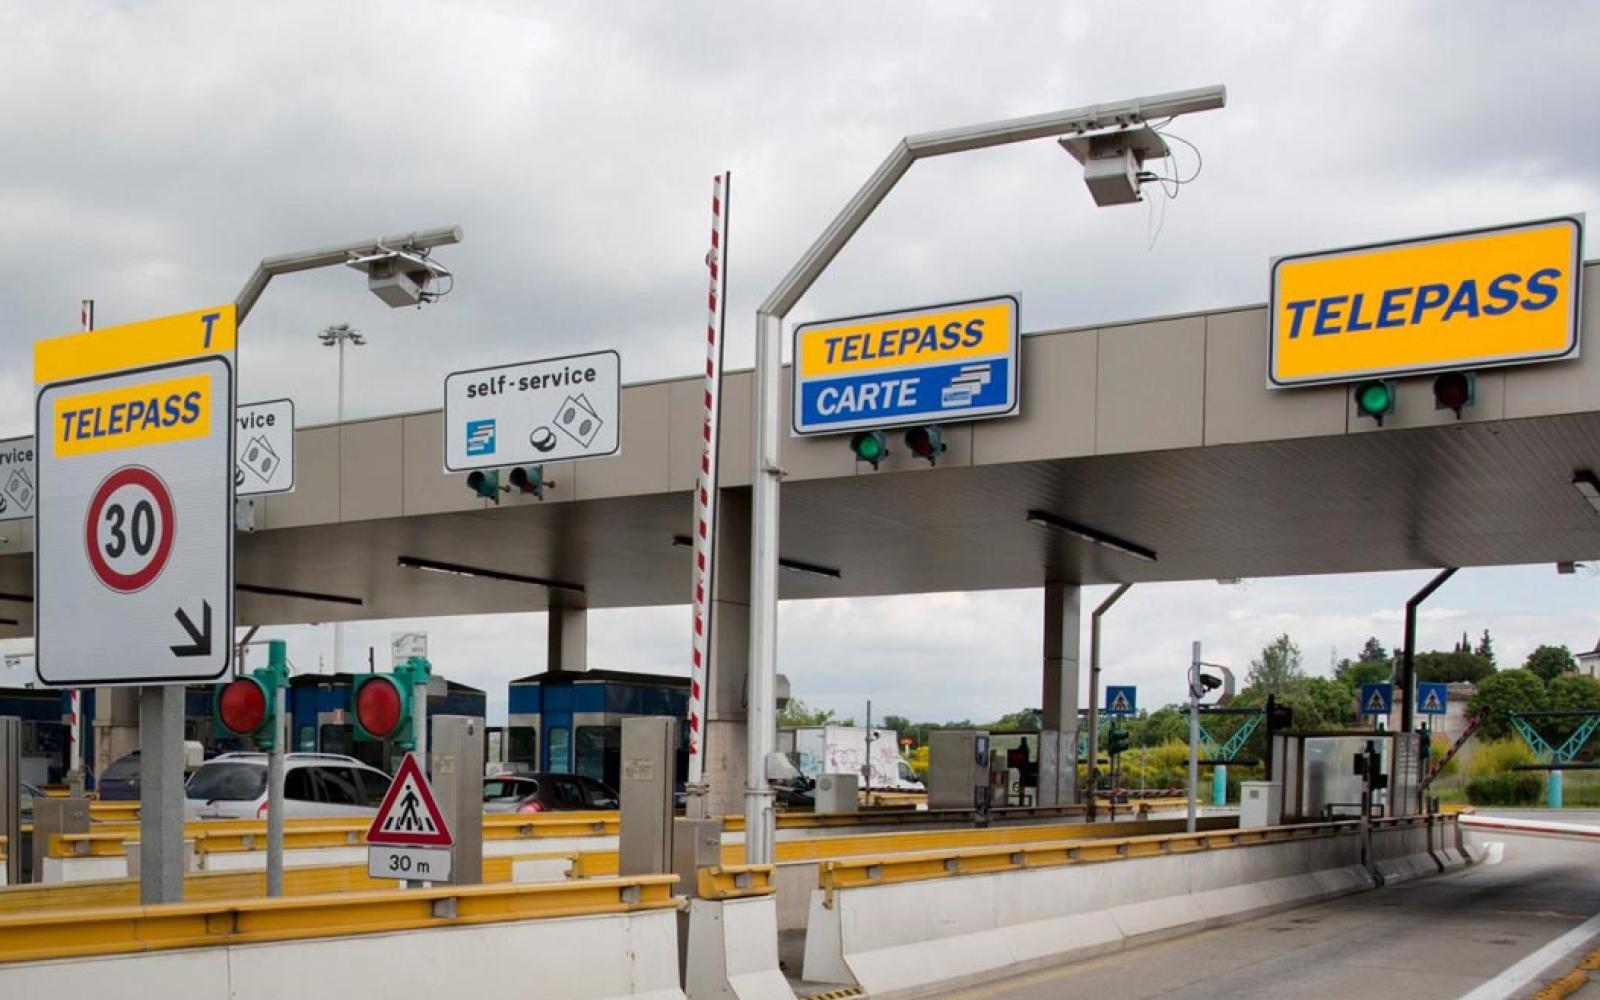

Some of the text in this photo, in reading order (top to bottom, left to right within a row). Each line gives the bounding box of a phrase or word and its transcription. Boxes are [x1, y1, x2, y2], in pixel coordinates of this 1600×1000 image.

[1286, 268, 1562, 339] TELEPASS
[201, 313, 220, 348] T
[824, 318, 985, 364] TELEPASS
[467, 366, 597, 398] self-service
[816, 377, 921, 416] CARTE
[61, 391, 201, 442] TELEPASS
[104, 500, 156, 559] 30
[389, 854, 430, 874] 30 m
